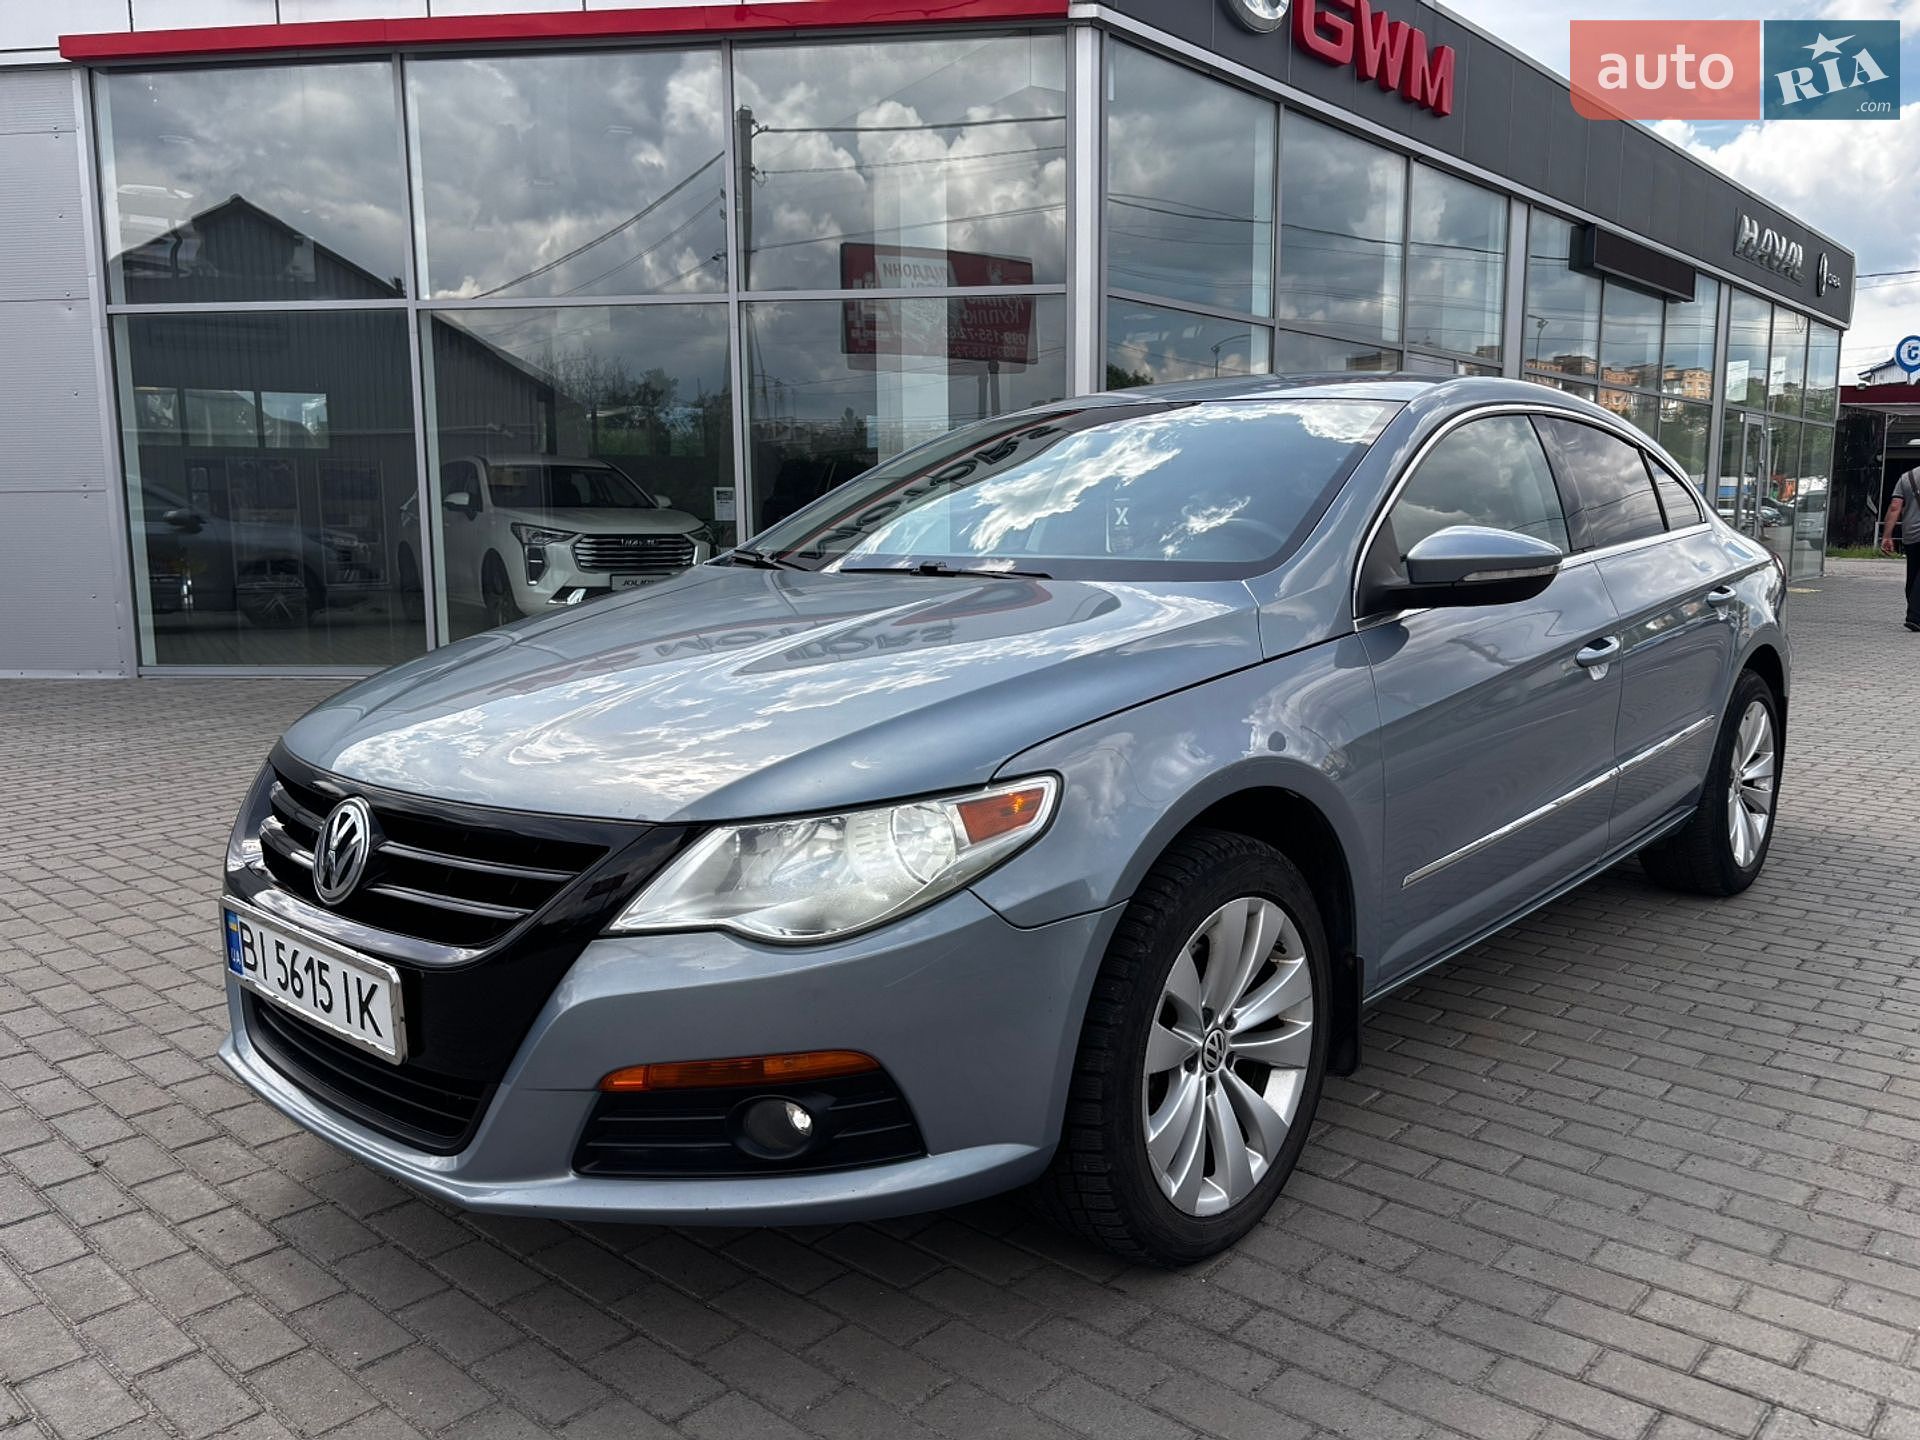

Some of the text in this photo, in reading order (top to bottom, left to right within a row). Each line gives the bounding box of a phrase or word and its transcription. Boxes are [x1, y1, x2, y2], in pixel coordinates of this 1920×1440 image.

[1293, 0, 1455, 116] GWM
[1737, 214, 1805, 281] HAVAL
[239, 921, 383, 1038] BI 5615 IK
